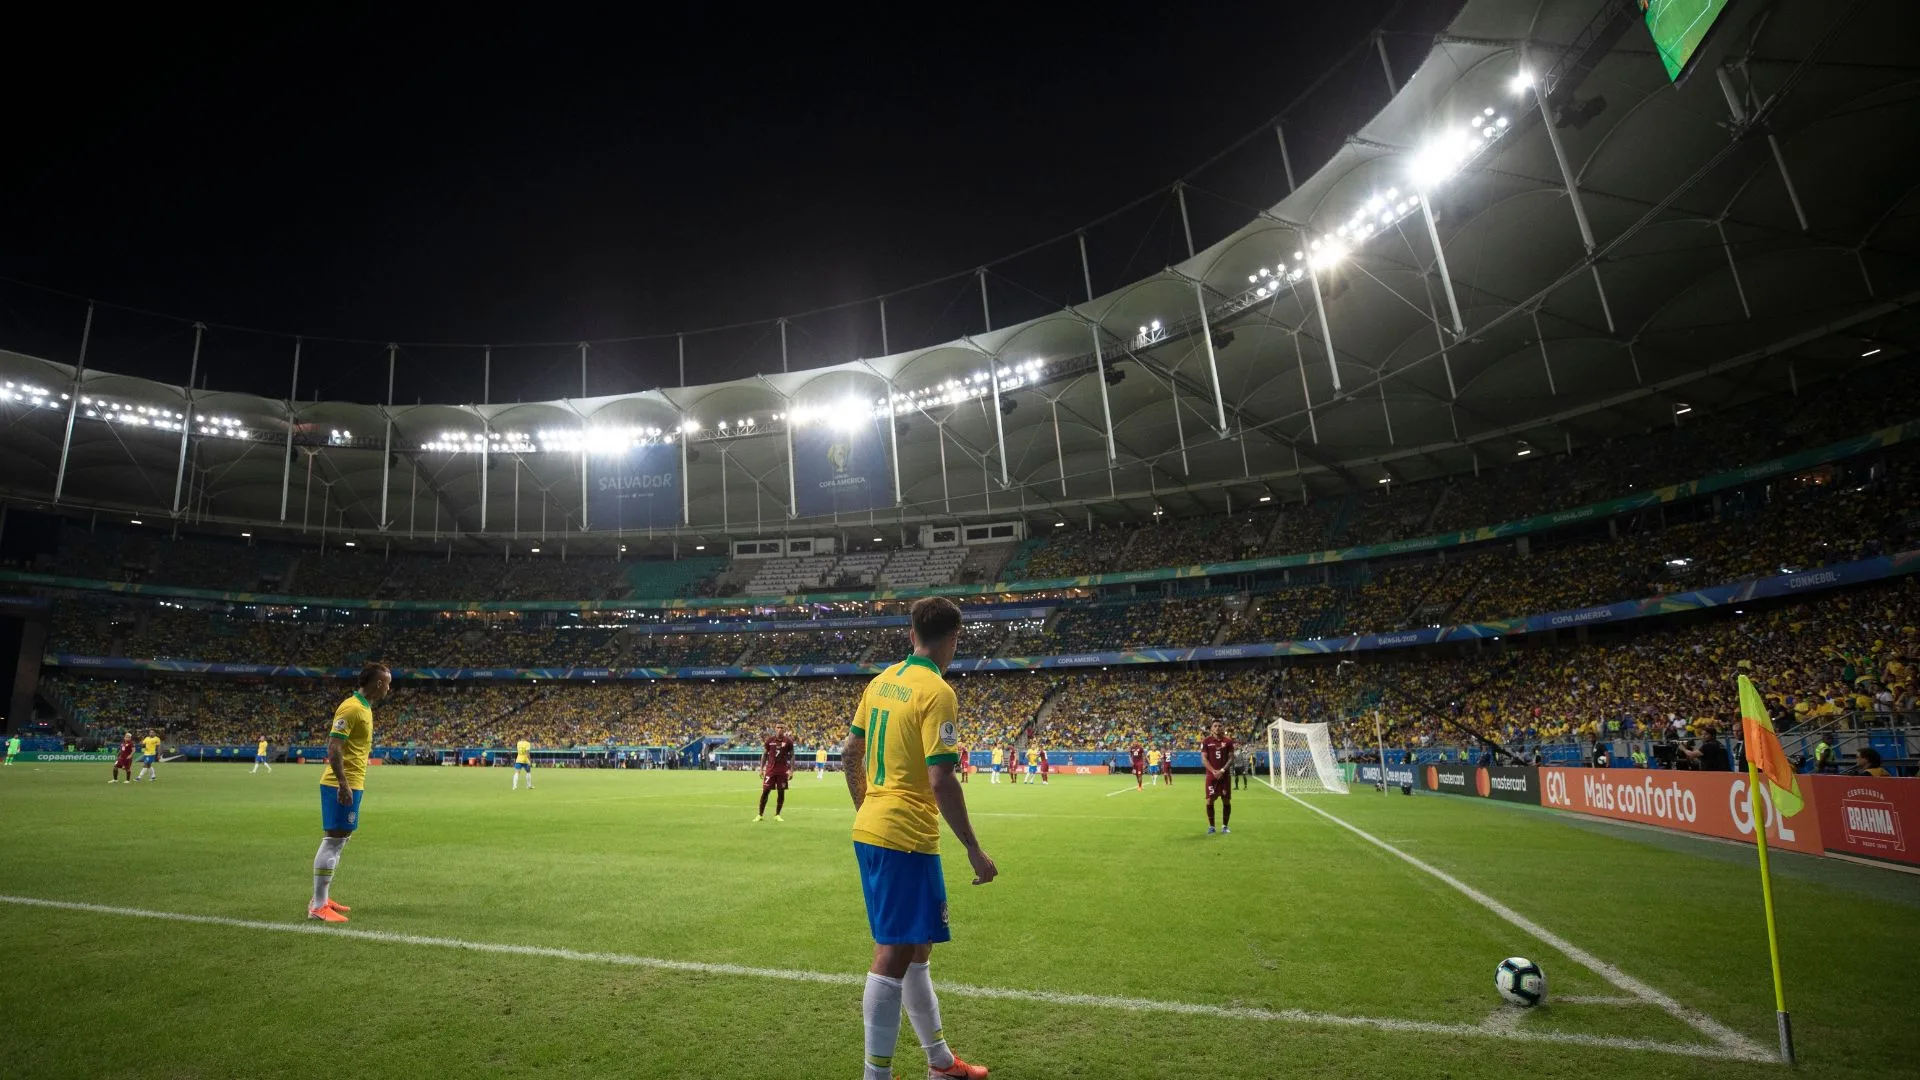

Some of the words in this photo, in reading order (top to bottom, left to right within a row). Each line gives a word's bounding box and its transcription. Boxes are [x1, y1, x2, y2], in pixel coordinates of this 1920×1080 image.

[598, 473, 673, 491] SALVADOR
[818, 480, 836, 488] COPA
[1789, 571, 1837, 588] CONMEBOL
[1552, 616, 1574, 625] COPA
[1215, 648, 1242, 657] CONMEBOL
[866, 707, 890, 786] 11
[38, 753, 116, 762] copaamerica.com
[775, 749, 781, 757] 7
[1215, 751, 1222, 759] 5
[1439, 771, 1465, 786] mastercard
[1492, 775, 1527, 792] mastercard
[1208, 786, 1215, 795] 5
[1546, 771, 1571, 806] GOL
[1584, 773, 1615, 811] Mais
[1617, 776, 1697, 823] conforto
[1729, 779, 1796, 842] GOL
[1847, 806, 1896, 836] BRAHMA
